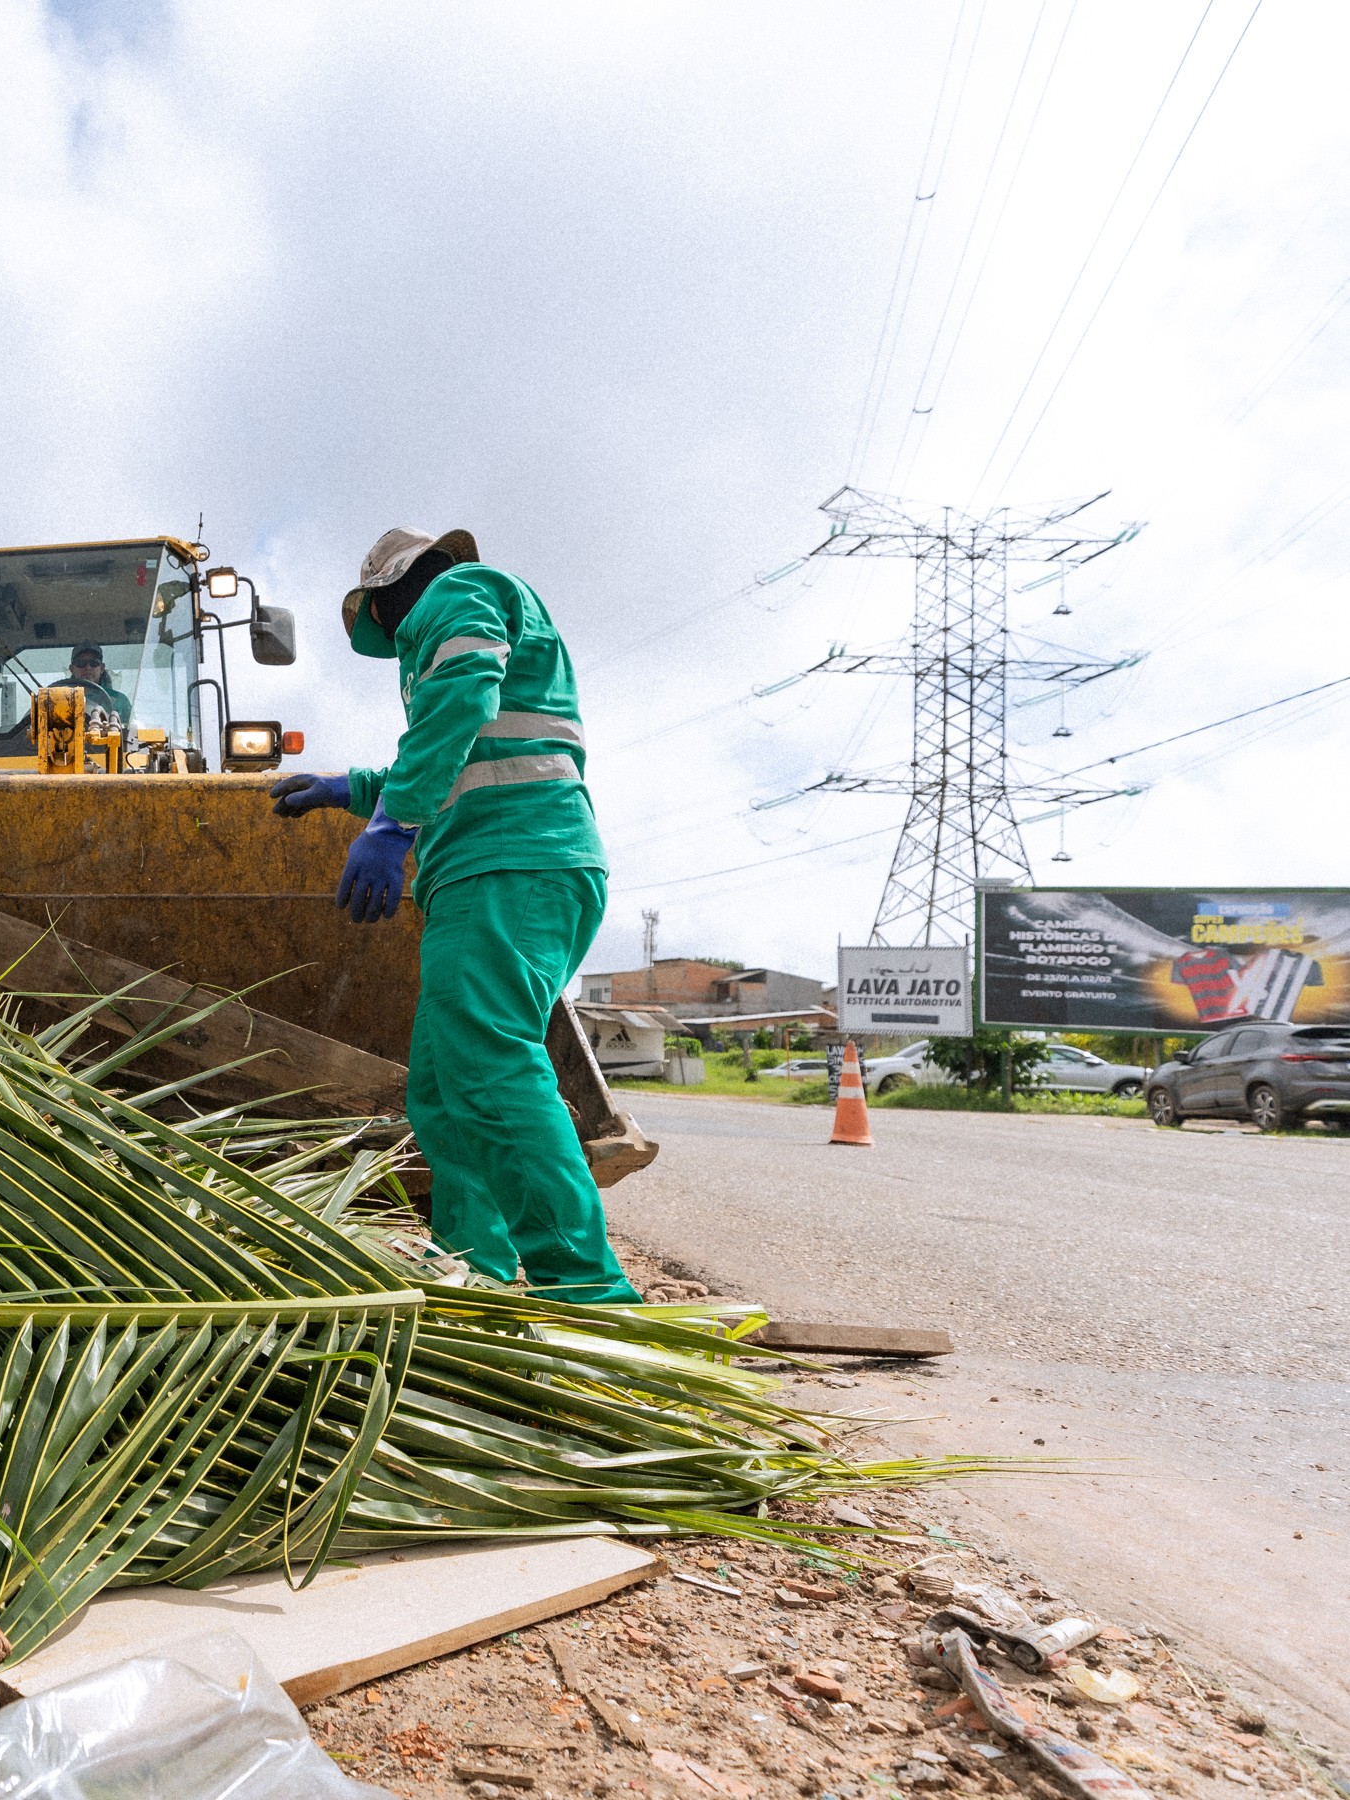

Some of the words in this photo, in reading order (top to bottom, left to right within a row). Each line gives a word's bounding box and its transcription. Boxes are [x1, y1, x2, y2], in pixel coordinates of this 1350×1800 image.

[1018, 942, 1104, 954] FLAMENGO
[1106, 944, 1118, 954] E
[1026, 954, 1111, 966] BOTAFOGO
[1026, 973, 1042, 982] DE
[846, 978, 900, 995] LAVA
[906, 979, 962, 996] JATO
[1021, 989, 1063, 998] EVENTO
[1063, 991, 1117, 1000] GRATUITO
[893, 997, 962, 1007] AUTOMOTIVA
